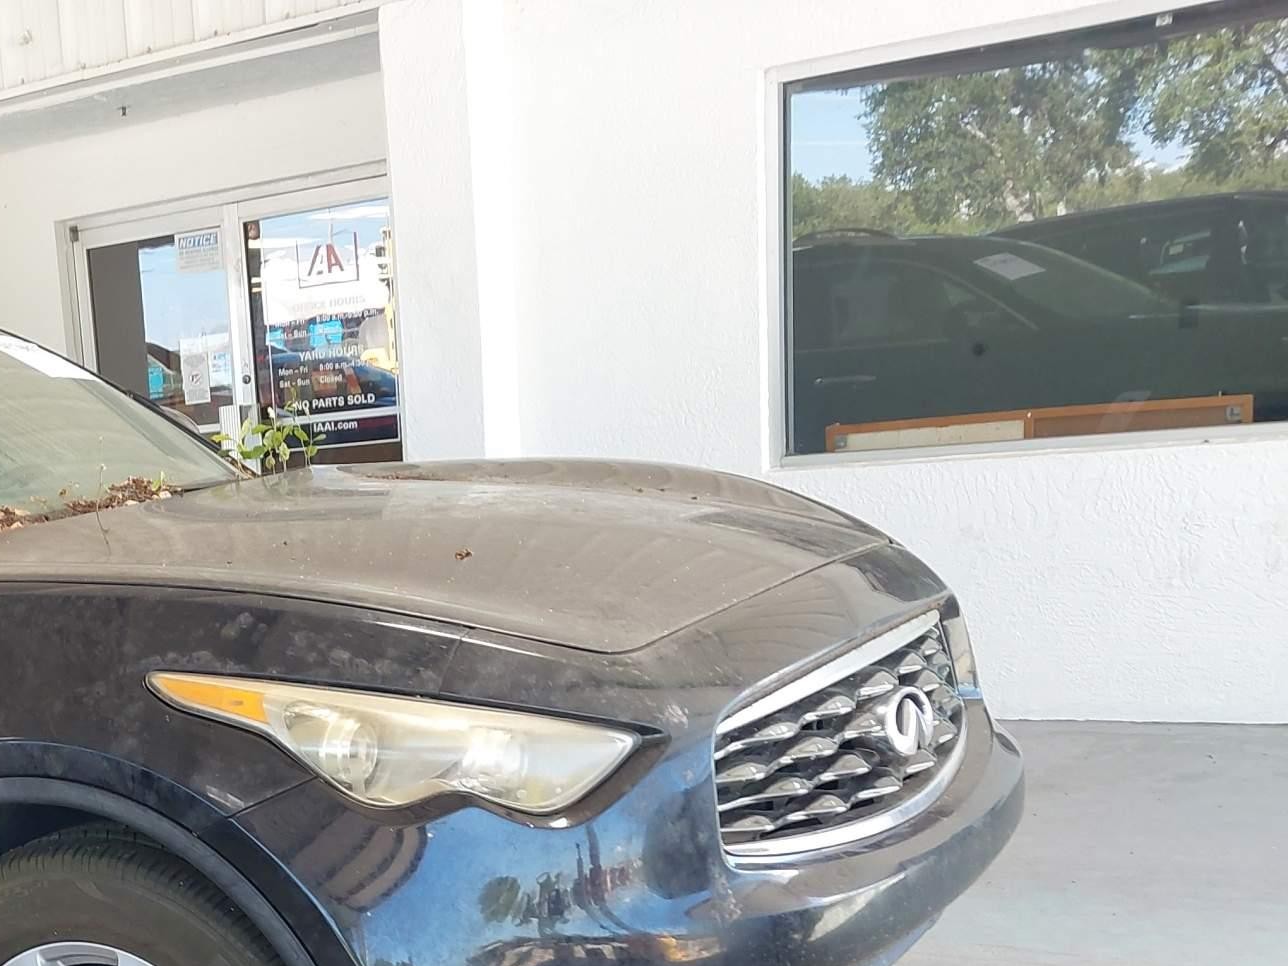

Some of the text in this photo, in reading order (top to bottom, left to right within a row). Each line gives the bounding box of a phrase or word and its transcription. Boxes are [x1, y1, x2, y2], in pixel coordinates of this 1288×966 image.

[179, 232, 217, 249] NOTICE
[295, 393, 376, 411] NO PARTS SOLD
[313, 421, 358, 433] IAAI.com
